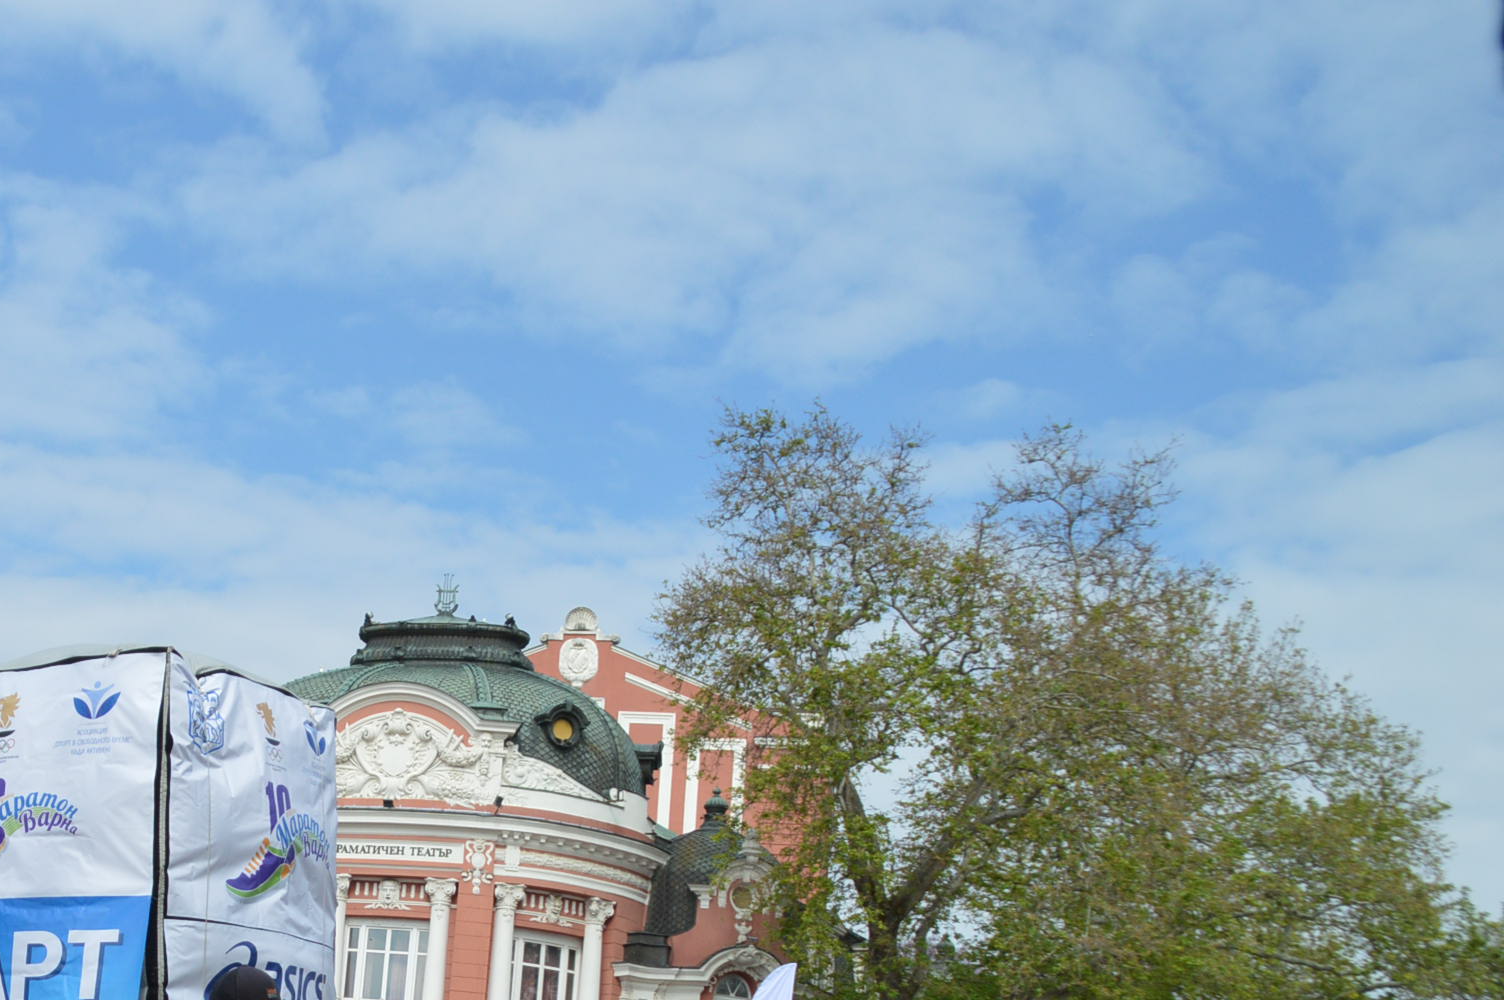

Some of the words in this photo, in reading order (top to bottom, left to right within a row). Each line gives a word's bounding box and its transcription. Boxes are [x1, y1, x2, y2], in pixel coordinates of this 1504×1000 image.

[19, 808, 78, 835] Варна
[336, 843, 405, 857] РАМАТИЧЕН
[409, 846, 453, 859] ТЕАТЪР
